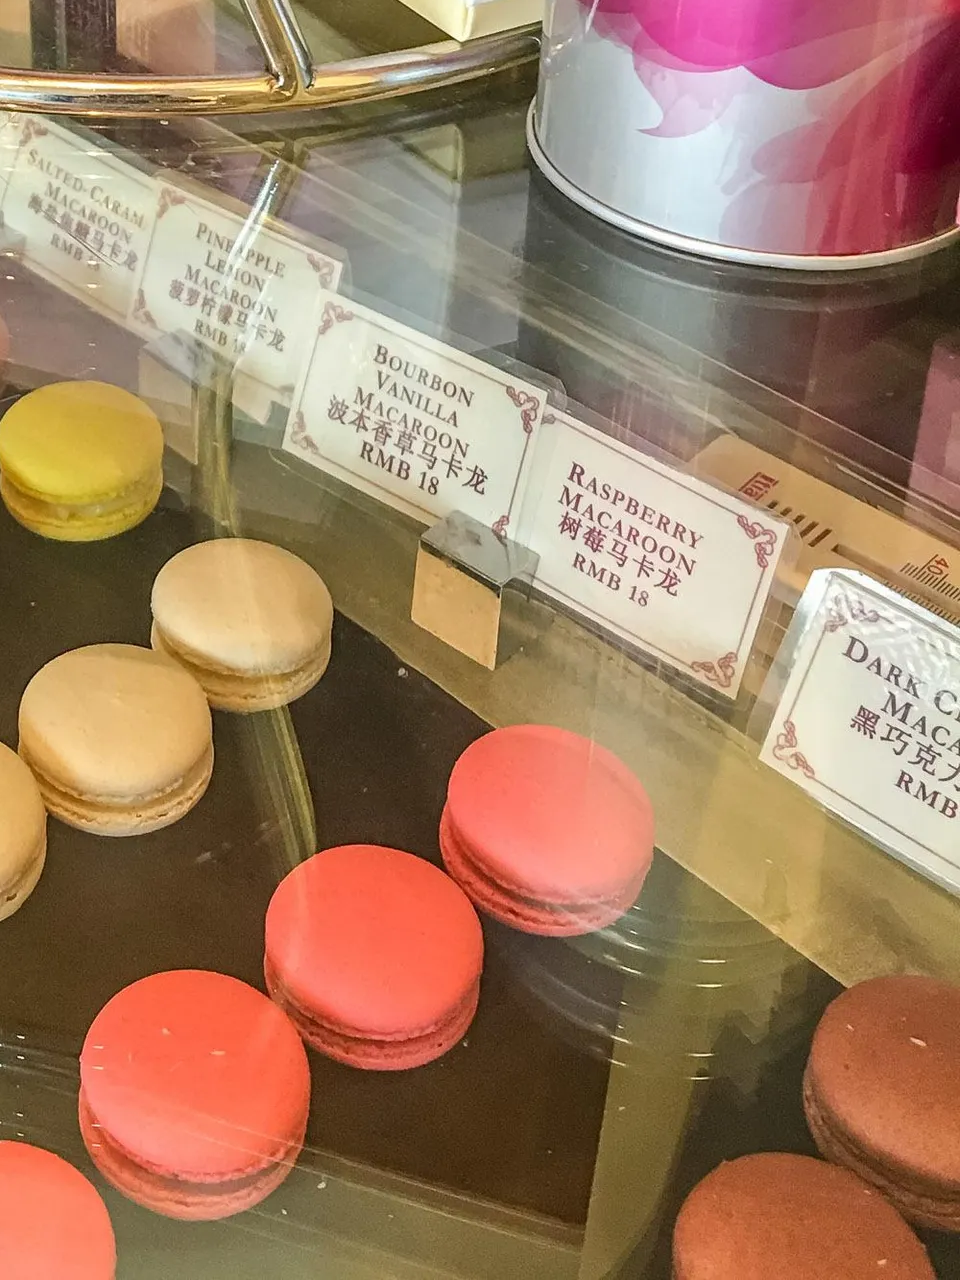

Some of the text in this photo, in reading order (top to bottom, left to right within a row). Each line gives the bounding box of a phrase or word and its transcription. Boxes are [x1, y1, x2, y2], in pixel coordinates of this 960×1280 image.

[44, 181, 134, 244] MACAROON
[50, 233, 84, 262] RMB
[204, 250, 267, 293] LEMON
[184, 264, 279, 324] MACAROON
[193, 319, 228, 347] RMB
[374, 343, 476, 408] BOURBON
[377, 370, 459, 429] VANILLA
[327, 394, 489, 496] 波本香草马卡龙
[353, 386, 471, 459] MACAROON
[359, 439, 440, 496] RMB 18
[558, 484, 698, 577] MACAROON
[567, 461, 705, 550] RASPBERRY
[558, 511, 682, 598] 树莓马卡龙
[572, 552, 650, 608] RMB 18
[842, 635, 927, 700] DARK
[895, 769, 959, 820] RMB
